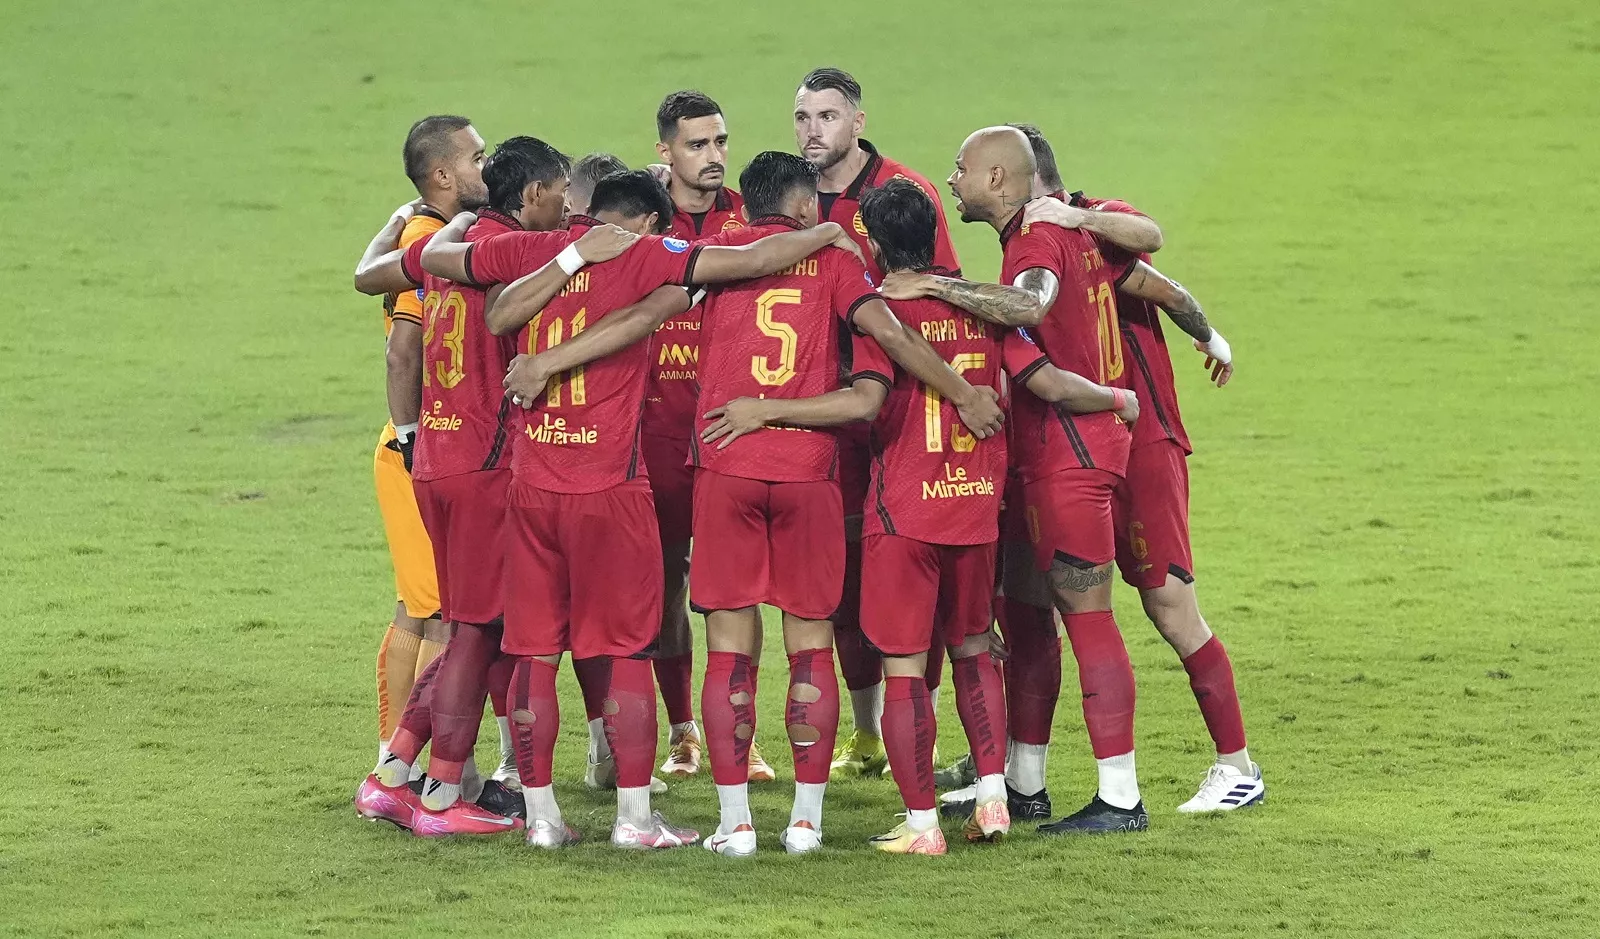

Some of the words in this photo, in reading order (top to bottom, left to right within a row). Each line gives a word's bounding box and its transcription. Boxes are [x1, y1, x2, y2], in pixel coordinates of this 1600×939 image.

[422, 289, 467, 389] 23
[751, 288, 802, 386] 5
[543, 413, 567, 431] Le
[921, 475, 995, 501] Minerale
[944, 462, 967, 482] Le
[1129, 521, 1148, 560] 6
